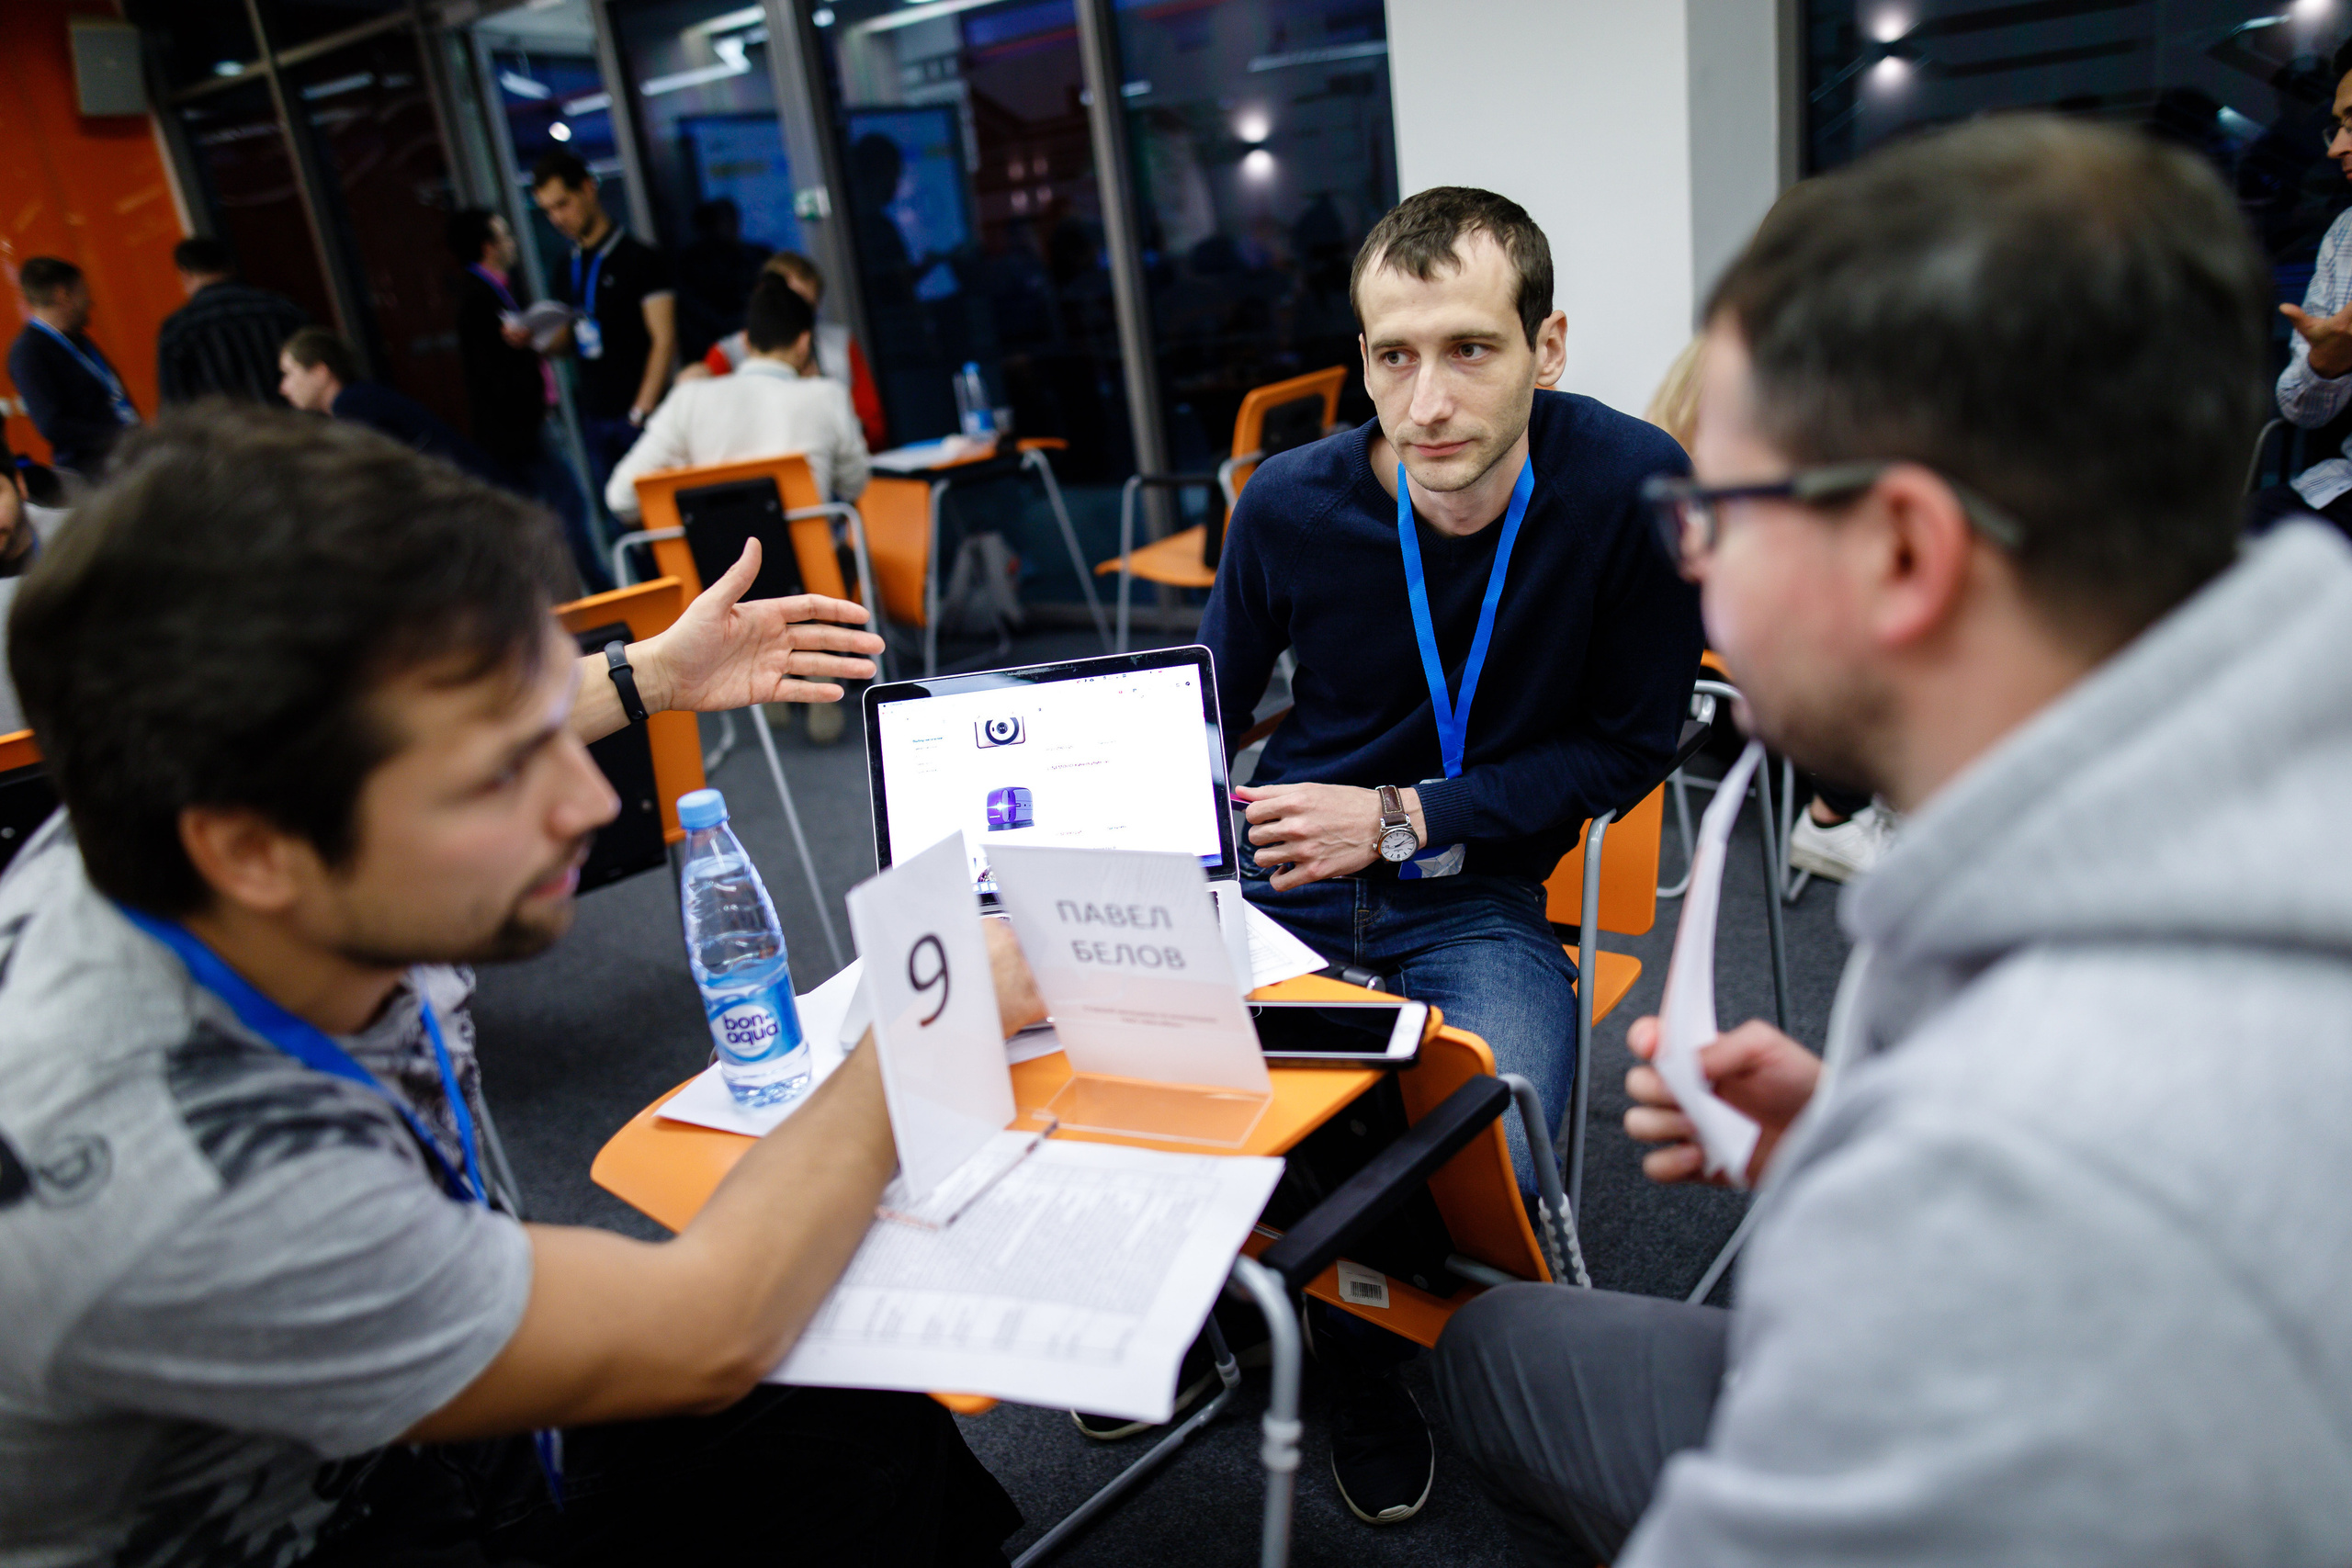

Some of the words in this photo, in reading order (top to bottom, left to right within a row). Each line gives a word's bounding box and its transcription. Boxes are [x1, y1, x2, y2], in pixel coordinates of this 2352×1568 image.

[1056, 899, 1173, 930] ПАВЕЛ
[1069, 939, 1186, 971] БЕЛОВ
[908, 933, 949, 1027] 9
[723, 1014, 763, 1031] bon
[726, 1021, 780, 1045] aqua
